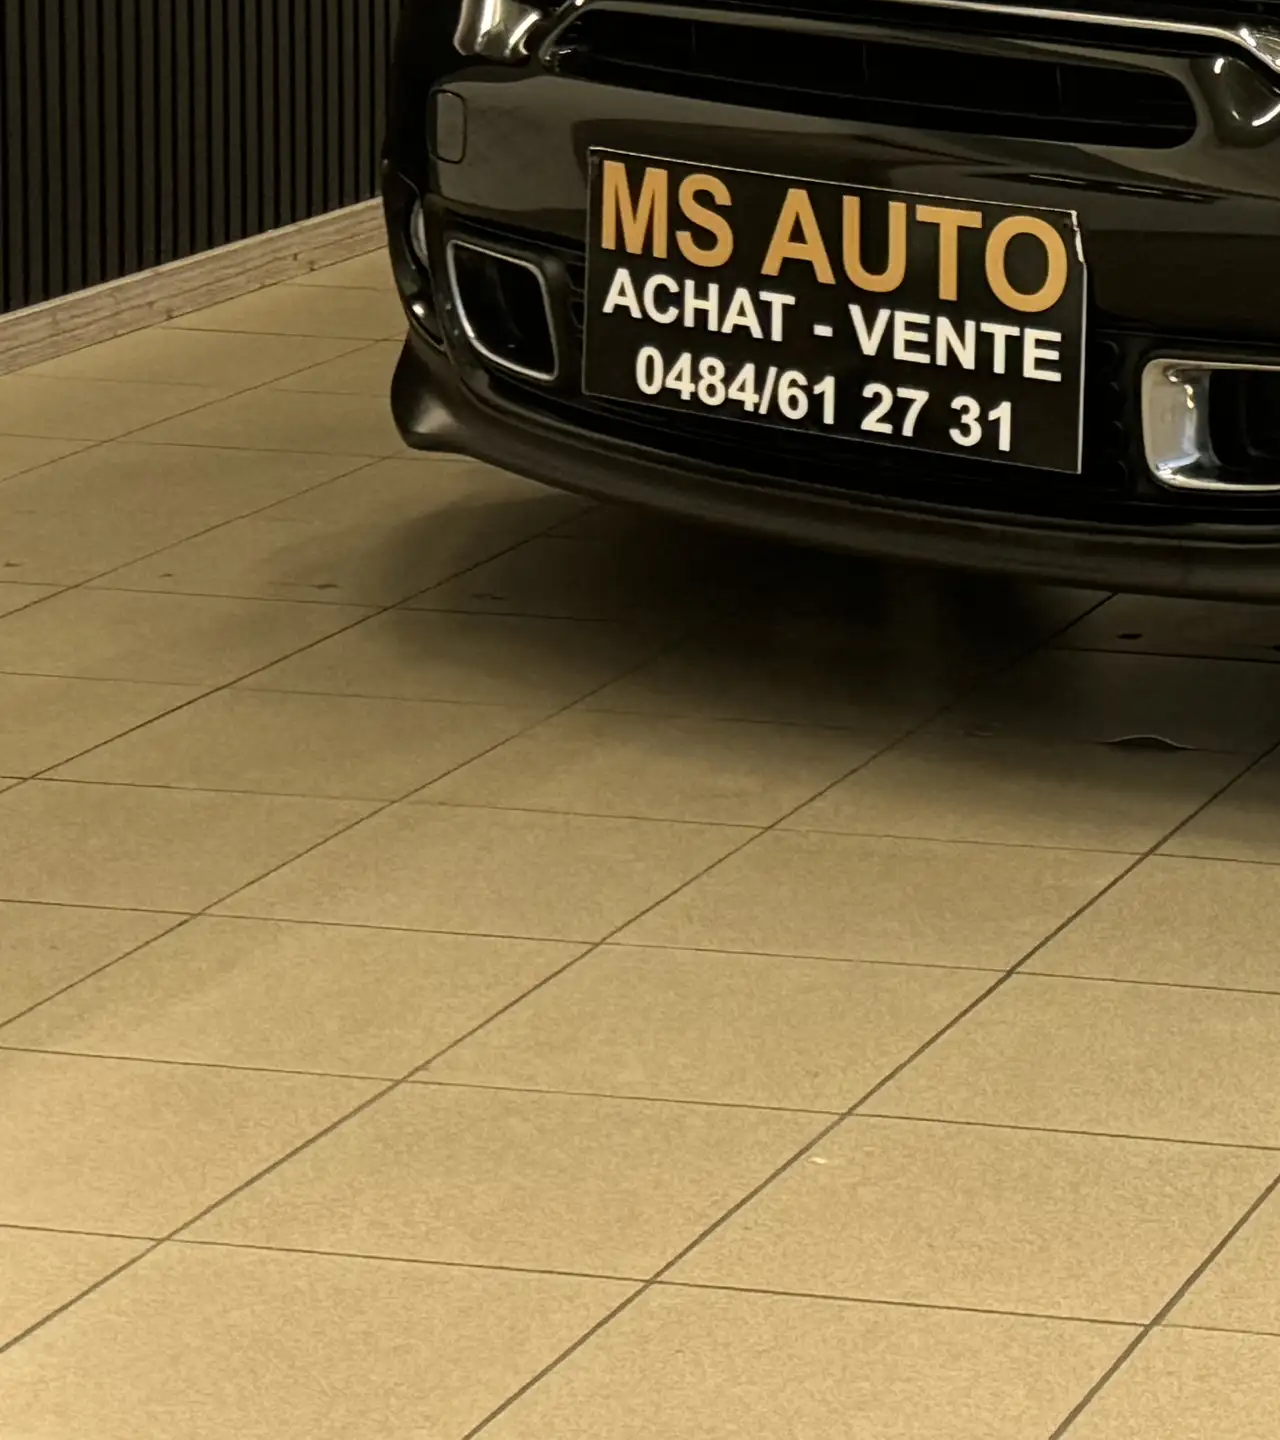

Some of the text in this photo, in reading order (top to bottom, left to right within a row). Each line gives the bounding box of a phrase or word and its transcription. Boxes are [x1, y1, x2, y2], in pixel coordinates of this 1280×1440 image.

[602, 160, 1067, 312] MS AUTO
[603, 268, 1061, 381] ACHAT - VENTE
[635, 346, 1010, 451] 0484/61 27 31
